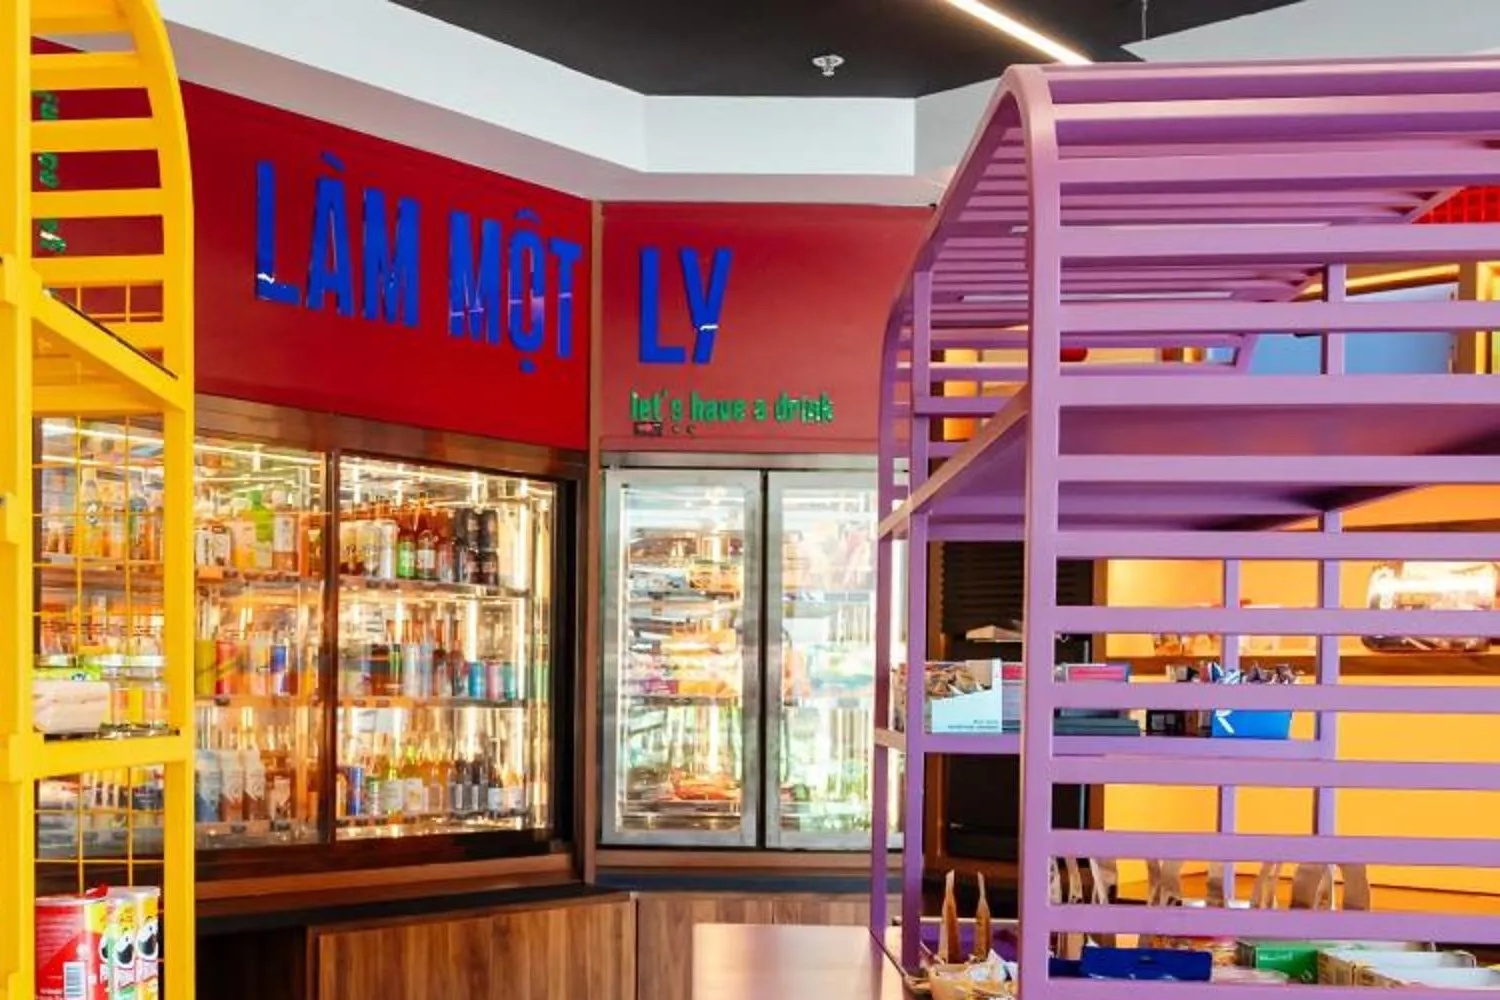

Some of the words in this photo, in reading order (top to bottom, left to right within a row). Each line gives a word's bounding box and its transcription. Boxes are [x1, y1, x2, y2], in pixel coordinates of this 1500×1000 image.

[256, 152, 420, 328] LÀM
[448, 208, 581, 374] MỘT
[639, 246, 732, 364] LY
[630, 388, 682, 422] let's
[690, 390, 747, 423] have
[753, 399, 767, 422] a
[775, 390, 835, 424] drink
